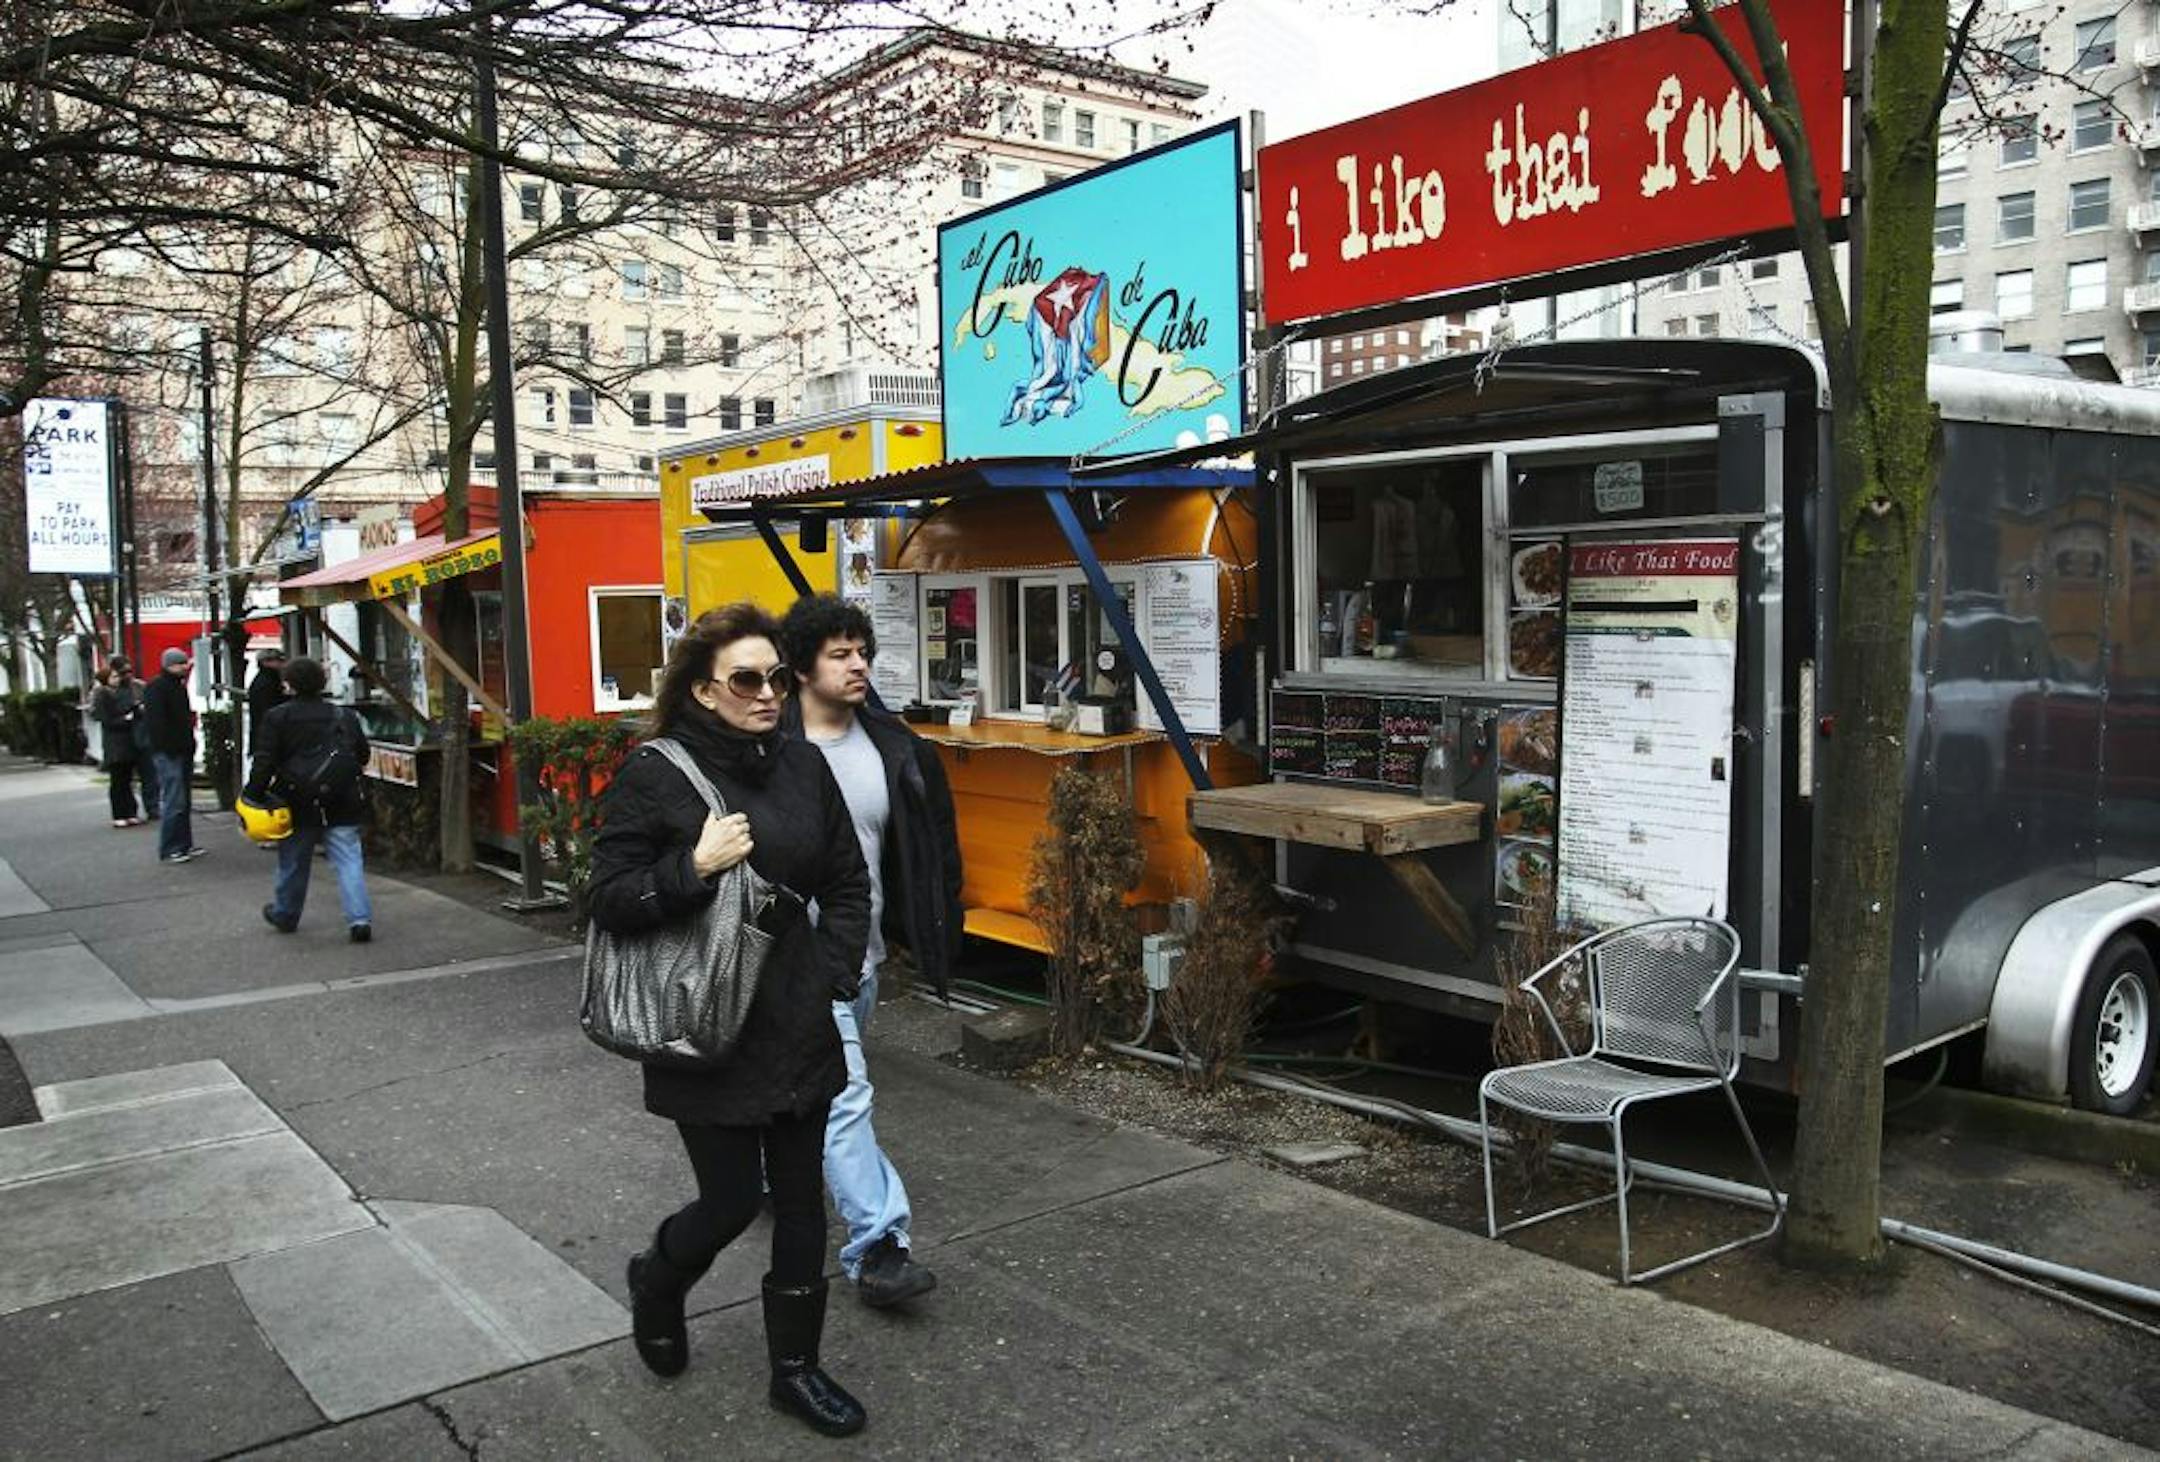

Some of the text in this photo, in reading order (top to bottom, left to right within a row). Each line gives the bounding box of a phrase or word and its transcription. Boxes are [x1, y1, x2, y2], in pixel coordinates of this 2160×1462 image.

[1286, 186, 1308, 271] i
[1336, 154, 1446, 262] like
[1485, 103, 1601, 227] thai
[960, 230, 1043, 338] el Cubo
[1118, 261, 1209, 407] de Cuba
[29, 424, 98, 443] PARK
[694, 463, 827, 501] Traditional Polish Cuisine
[41, 517, 97, 529] TO PARK
[57, 501, 80, 514] PAY
[31, 531, 108, 546] ALL HOURS
[424, 548, 498, 584] RODEO
[1585, 550, 1626, 574] Like
[1634, 549, 1678, 570] Thai
[1684, 548, 1738, 570] Food
